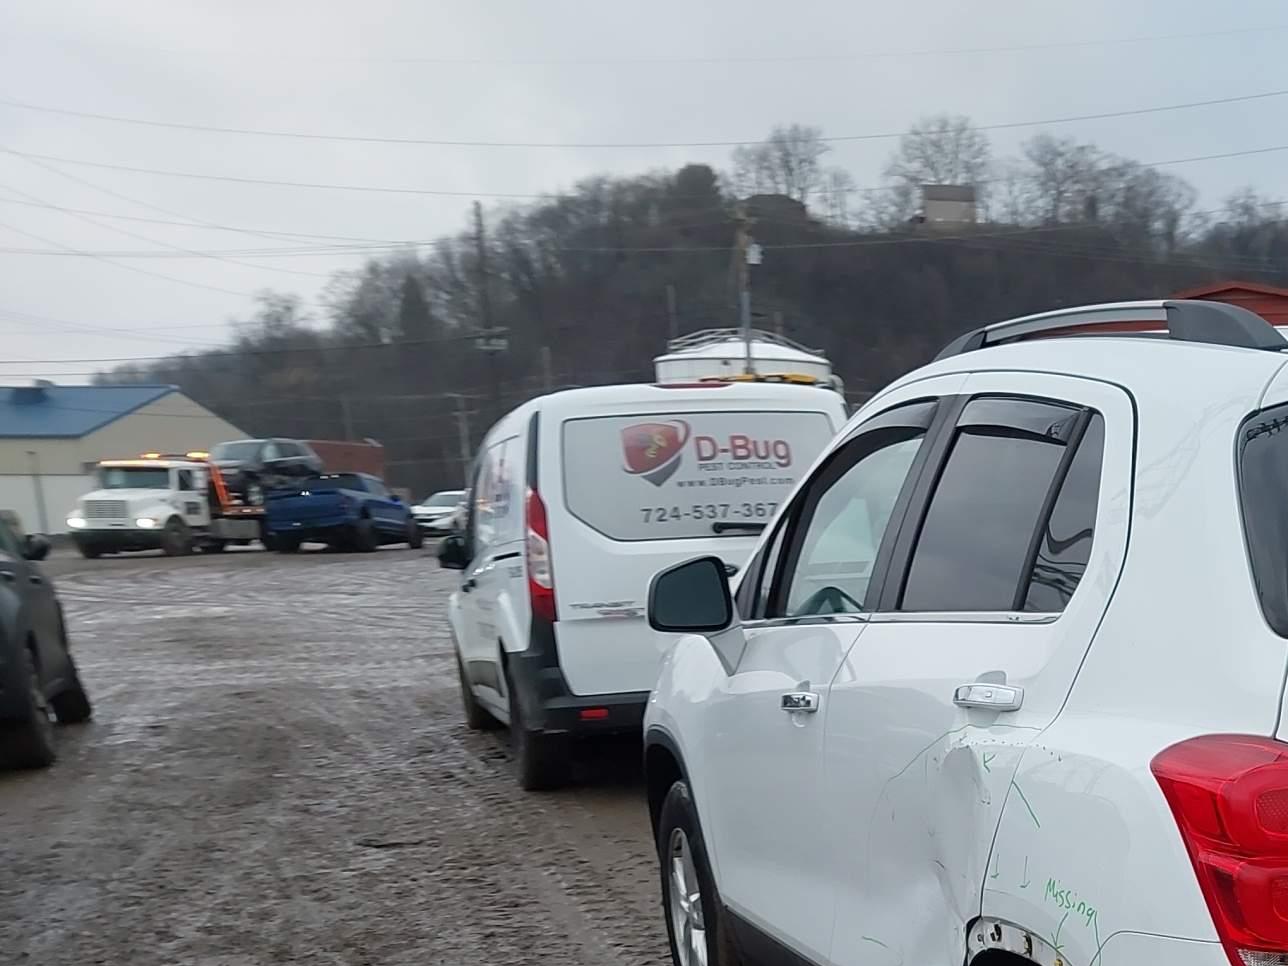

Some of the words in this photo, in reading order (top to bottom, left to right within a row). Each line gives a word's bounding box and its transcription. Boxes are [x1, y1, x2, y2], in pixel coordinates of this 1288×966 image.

[694, 435, 791, 467] D-Bug
[698, 462, 724, 471] PEST
[728, 461, 777, 470] CONTROL
[640, 502, 780, 523] 724-537-367
[1044, 877, 1096, 927] Missing
